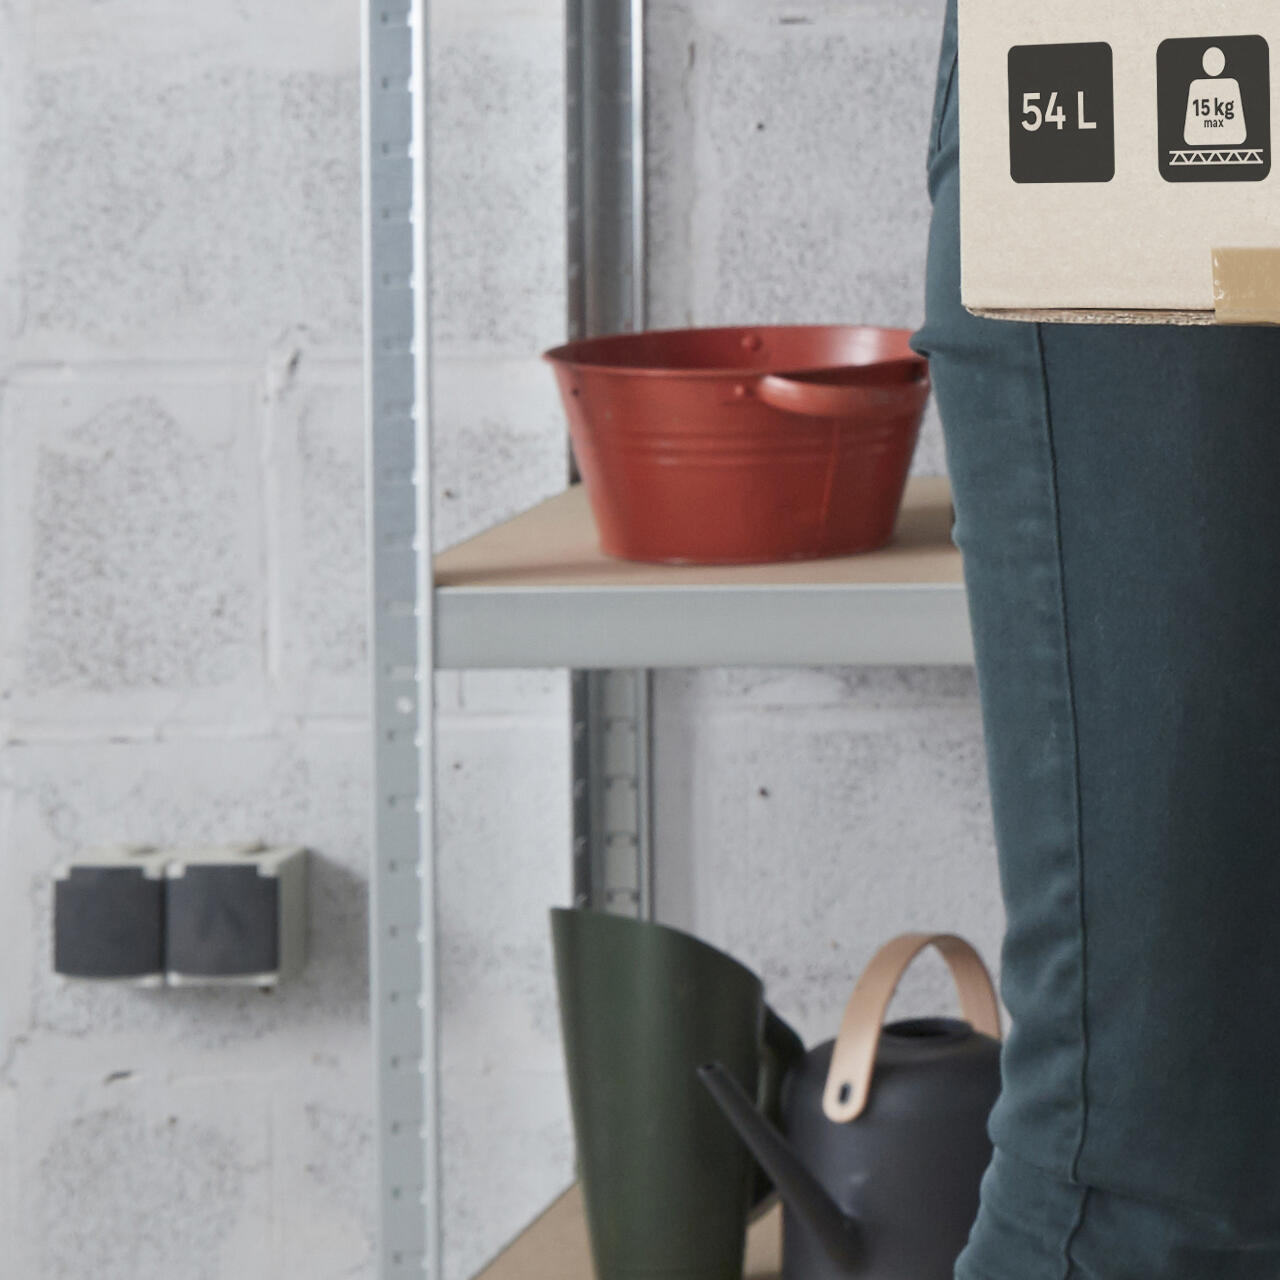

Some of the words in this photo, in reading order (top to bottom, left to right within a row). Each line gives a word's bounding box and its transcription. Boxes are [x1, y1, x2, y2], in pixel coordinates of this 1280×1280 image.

[1021, 92, 1066, 132] 54
[1077, 91, 1097, 130] L
[1192, 98, 1211, 117] 15
[1213, 97, 1235, 121] kg
[1204, 119, 1225, 128] max
